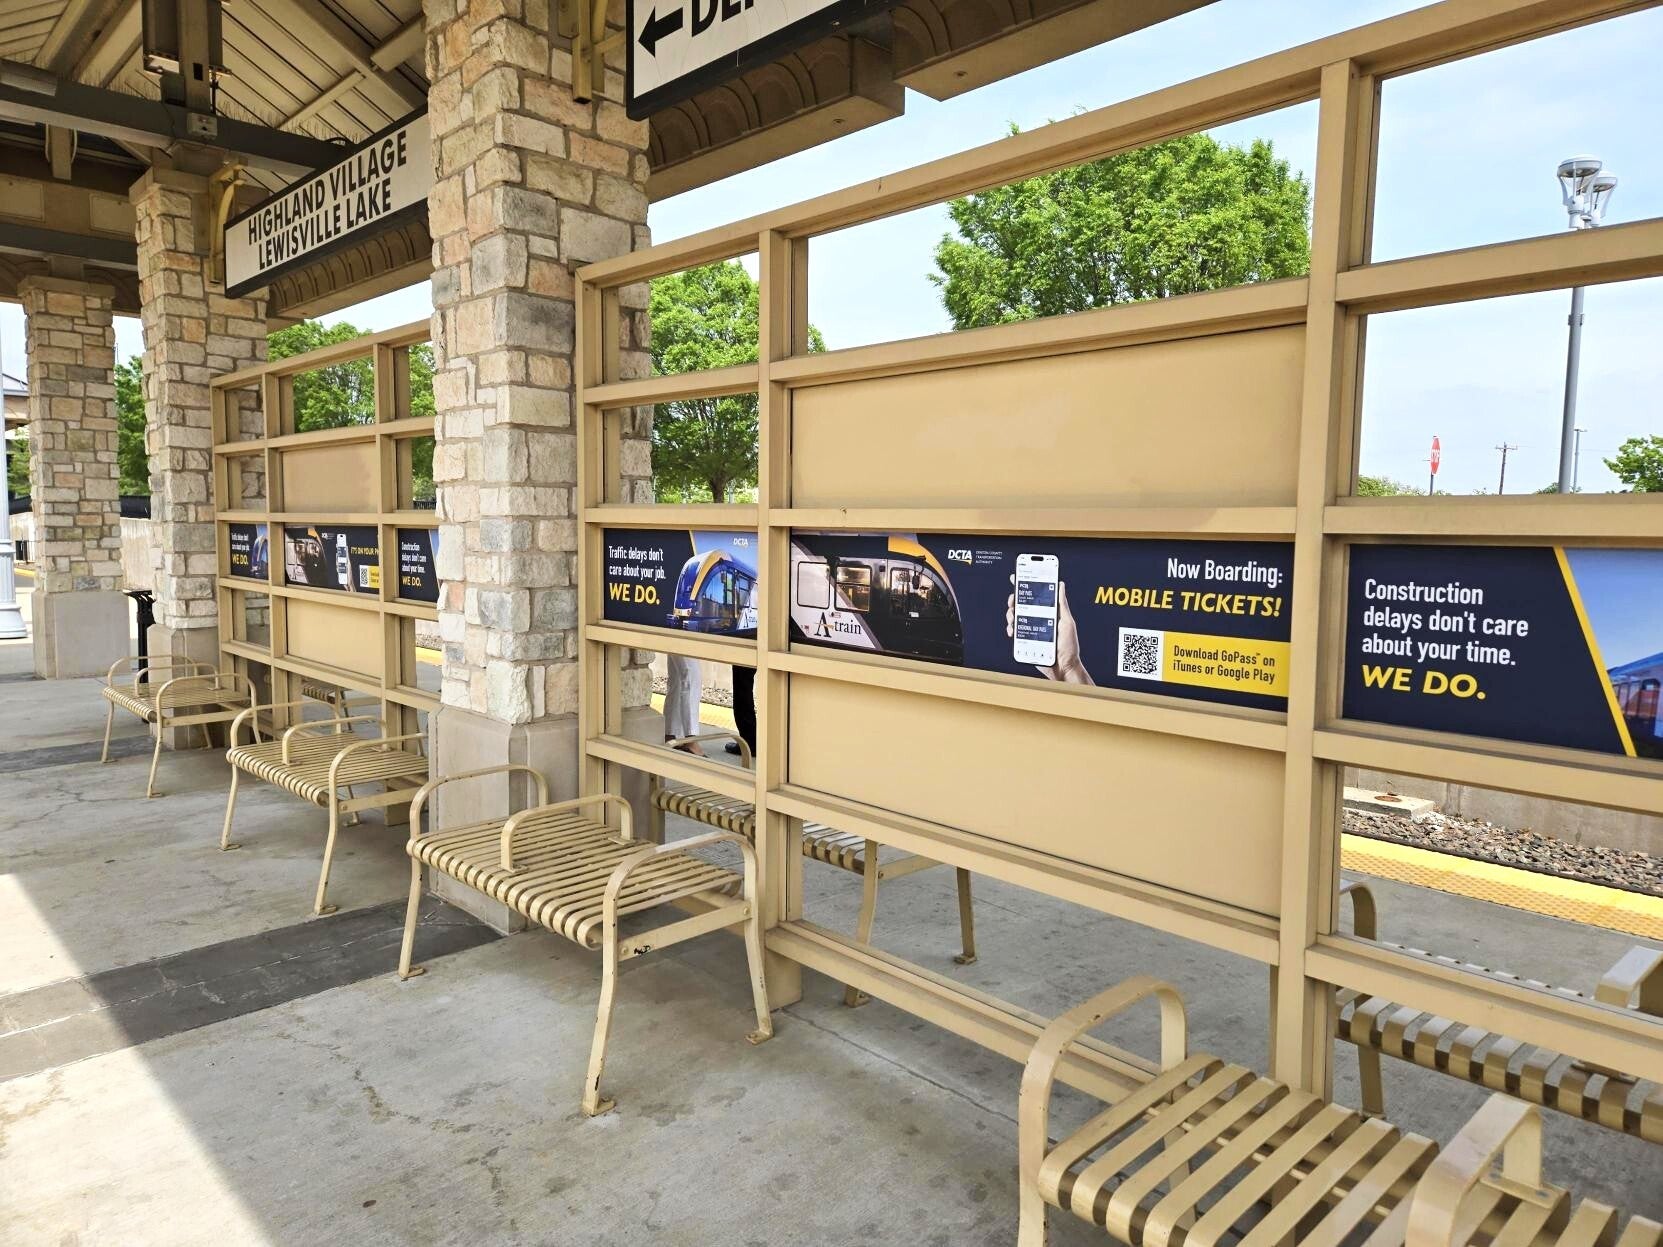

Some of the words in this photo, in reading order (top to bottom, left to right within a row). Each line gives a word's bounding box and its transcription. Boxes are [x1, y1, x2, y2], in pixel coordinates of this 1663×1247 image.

[249, 179, 325, 245] HIGHLAND
[330, 130, 407, 201] VILLAGE
[259, 203, 341, 270] LEWISVILLE
[347, 177, 391, 229] LAKE
[608, 545, 627, 559] Traffic
[628, 547, 648, 563] delays
[648, 548, 664, 562] don't
[732, 538, 749, 546] DCTA
[948, 550, 972, 560] DCTA
[402, 576, 411, 586] WE
[608, 565, 622, 576] care
[623, 564, 639, 577] about
[640, 567, 653, 581] your
[654, 566, 666, 582] job.
[1167, 558, 1200, 579] Now
[1204, 559, 1283, 588] Boarding:
[609, 582, 630, 602] WE
[634, 585, 660, 605] DO.
[1094, 586, 1174, 609] MOBILE
[1180, 592, 1282, 617] TICKETS!
[1364, 578, 1484, 605] Construction
[1363, 606, 1422, 634] delays
[1428, 610, 1476, 634] don't
[1482, 616, 1529, 637] care
[1174, 645, 1218, 661] Download
[1262, 656, 1275, 666] on
[1362, 634, 1412, 657] about
[1417, 642, 1461, 664] your
[1466, 640, 1516, 666] time.
[1173, 660, 1202, 673] iTunes
[1204, 665, 1214, 675] or
[1218, 664, 1250, 682] Google
[1253, 668, 1275, 685] Play
[1362, 664, 1413, 692] WE
[1422, 670, 1487, 700] DO.
